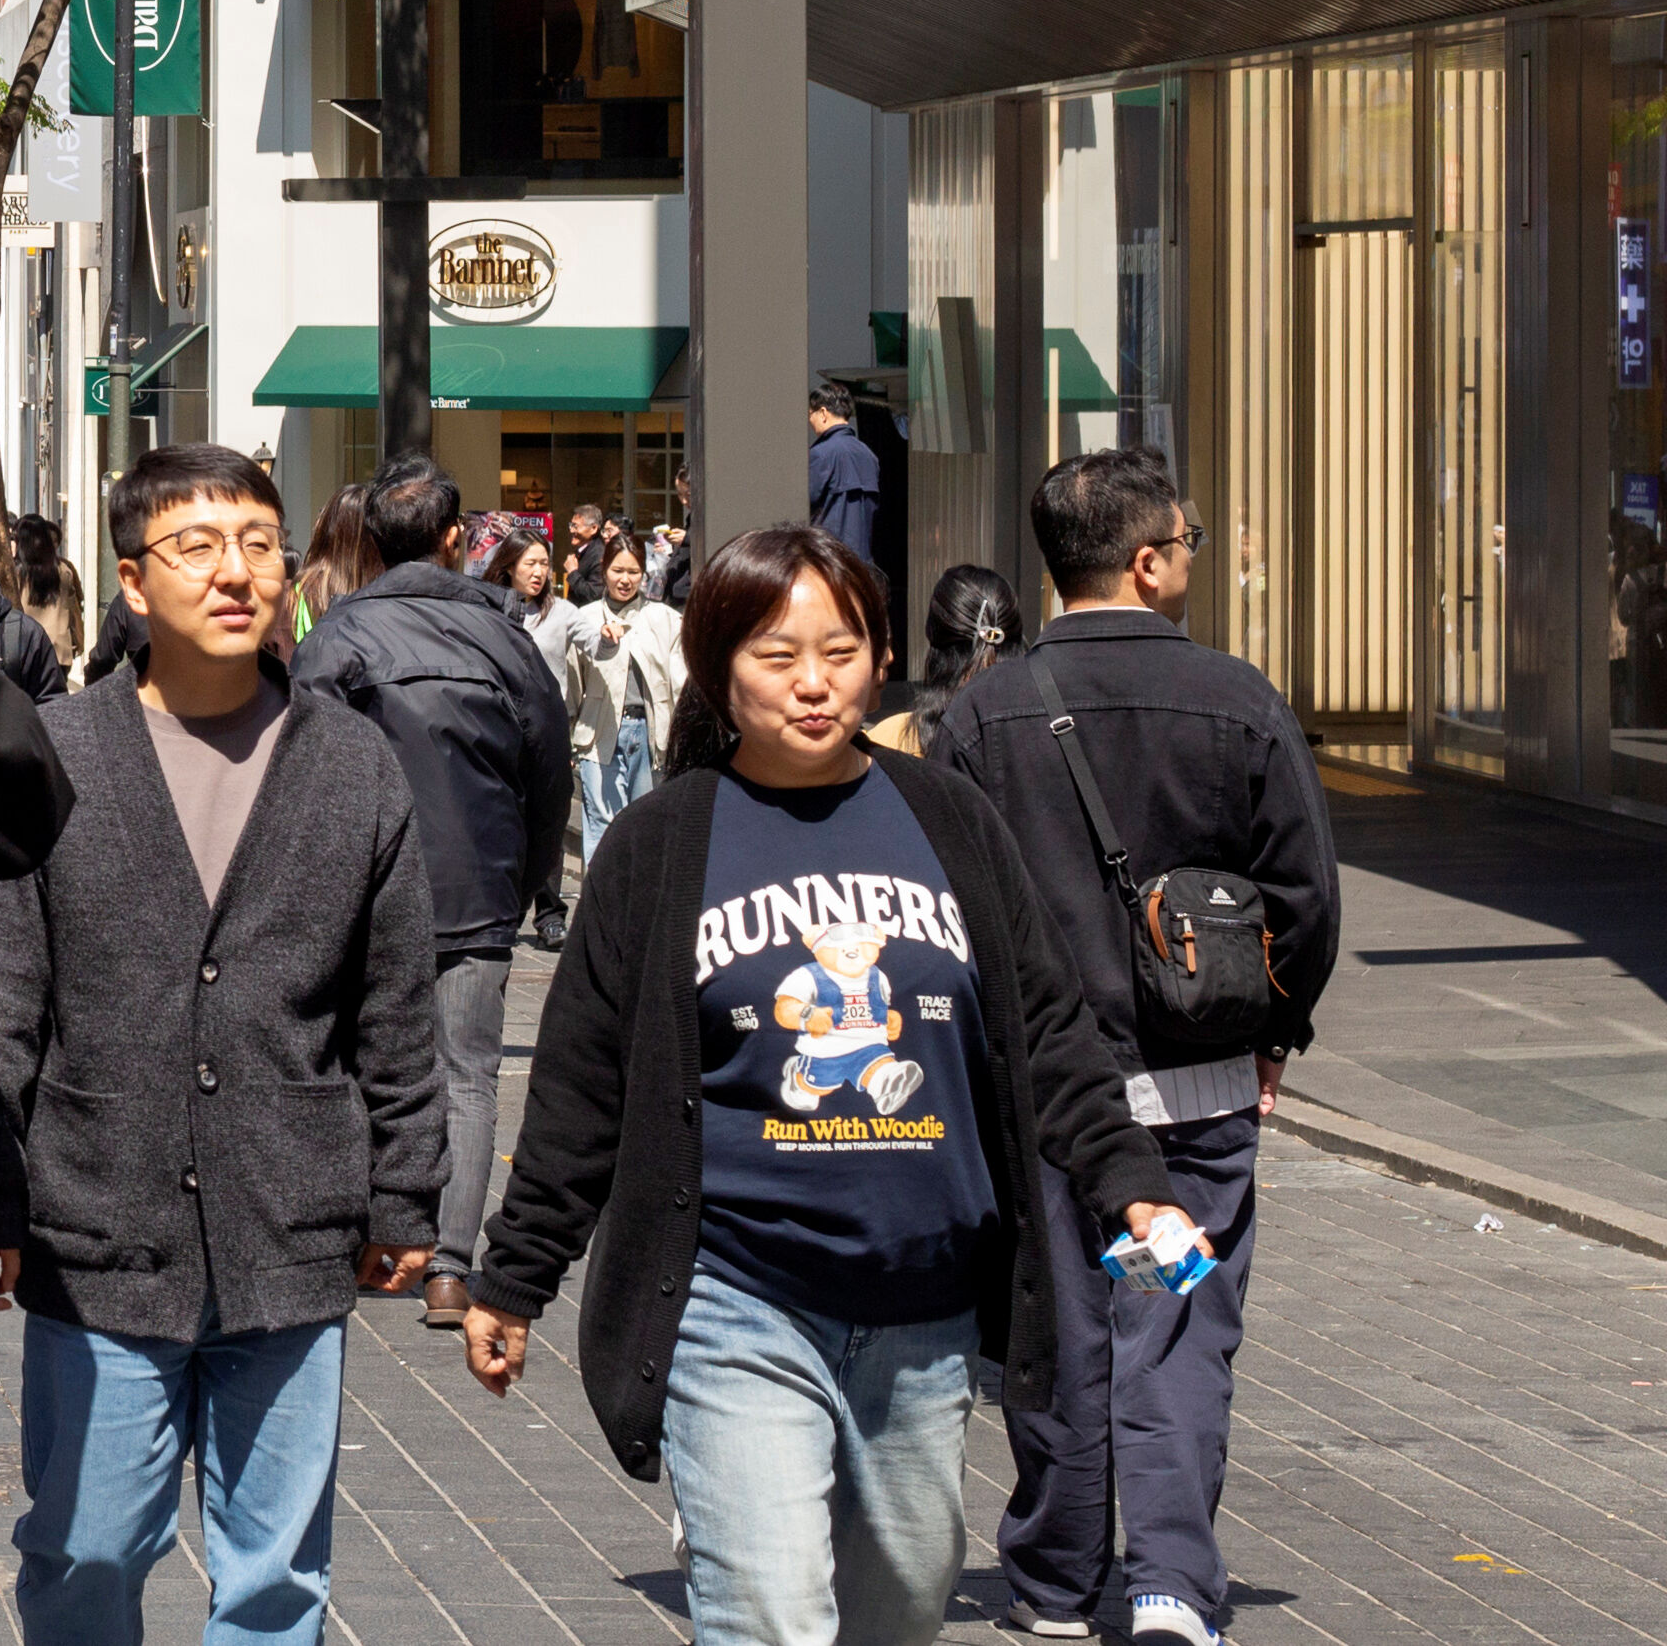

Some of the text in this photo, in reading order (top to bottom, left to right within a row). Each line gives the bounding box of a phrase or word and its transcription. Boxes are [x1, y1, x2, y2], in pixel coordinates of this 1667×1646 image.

[475, 231, 502, 254] the
[436, 248, 539, 285] Barnnet
[513, 516, 544, 527] OPEN
[694, 872, 970, 986] RUNNERS
[917, 994, 953, 1009] TRACK
[730, 1005, 757, 1019] EST.
[920, 1007, 952, 1021] RACE
[762, 1114, 945, 1140] Run With Woodie
[775, 1141, 798, 1152] KEEP
[891, 1140, 916, 1151] EVERY
